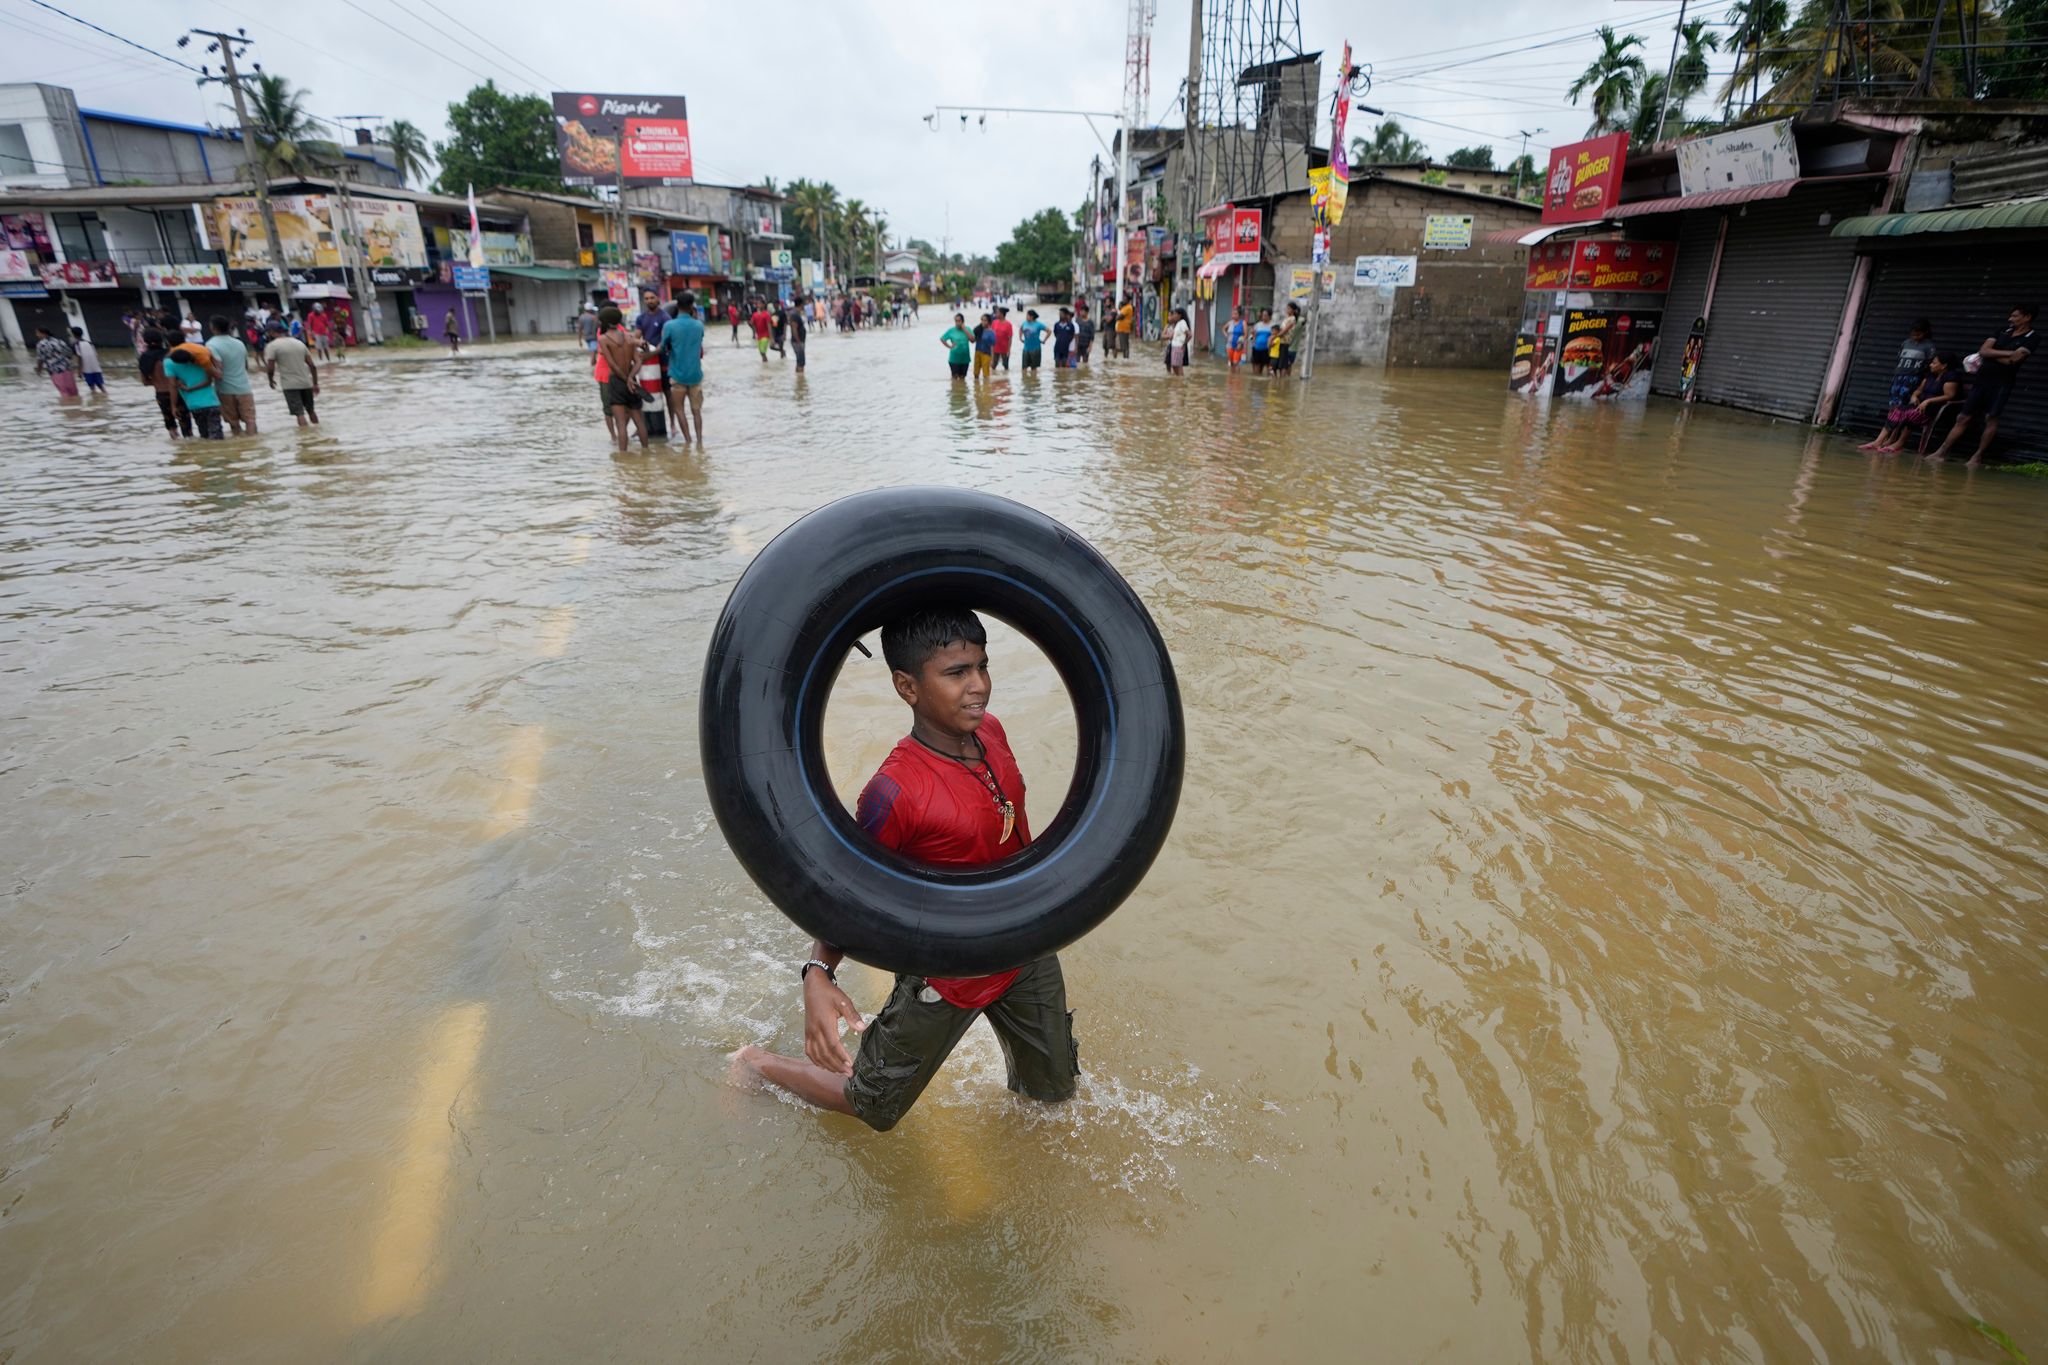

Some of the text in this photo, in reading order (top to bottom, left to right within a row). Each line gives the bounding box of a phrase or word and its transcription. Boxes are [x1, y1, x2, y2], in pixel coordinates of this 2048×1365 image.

[601, 99, 662, 115] Pizza Hut
[1577, 151, 1591, 165] MR.
[1574, 155, 1611, 188] BURGER
[1595, 264, 1612, 274] MR.
[1593, 271, 1639, 288] BURGER
[1570, 311, 1585, 321] MR.
[1568, 318, 1608, 333] BURGER
